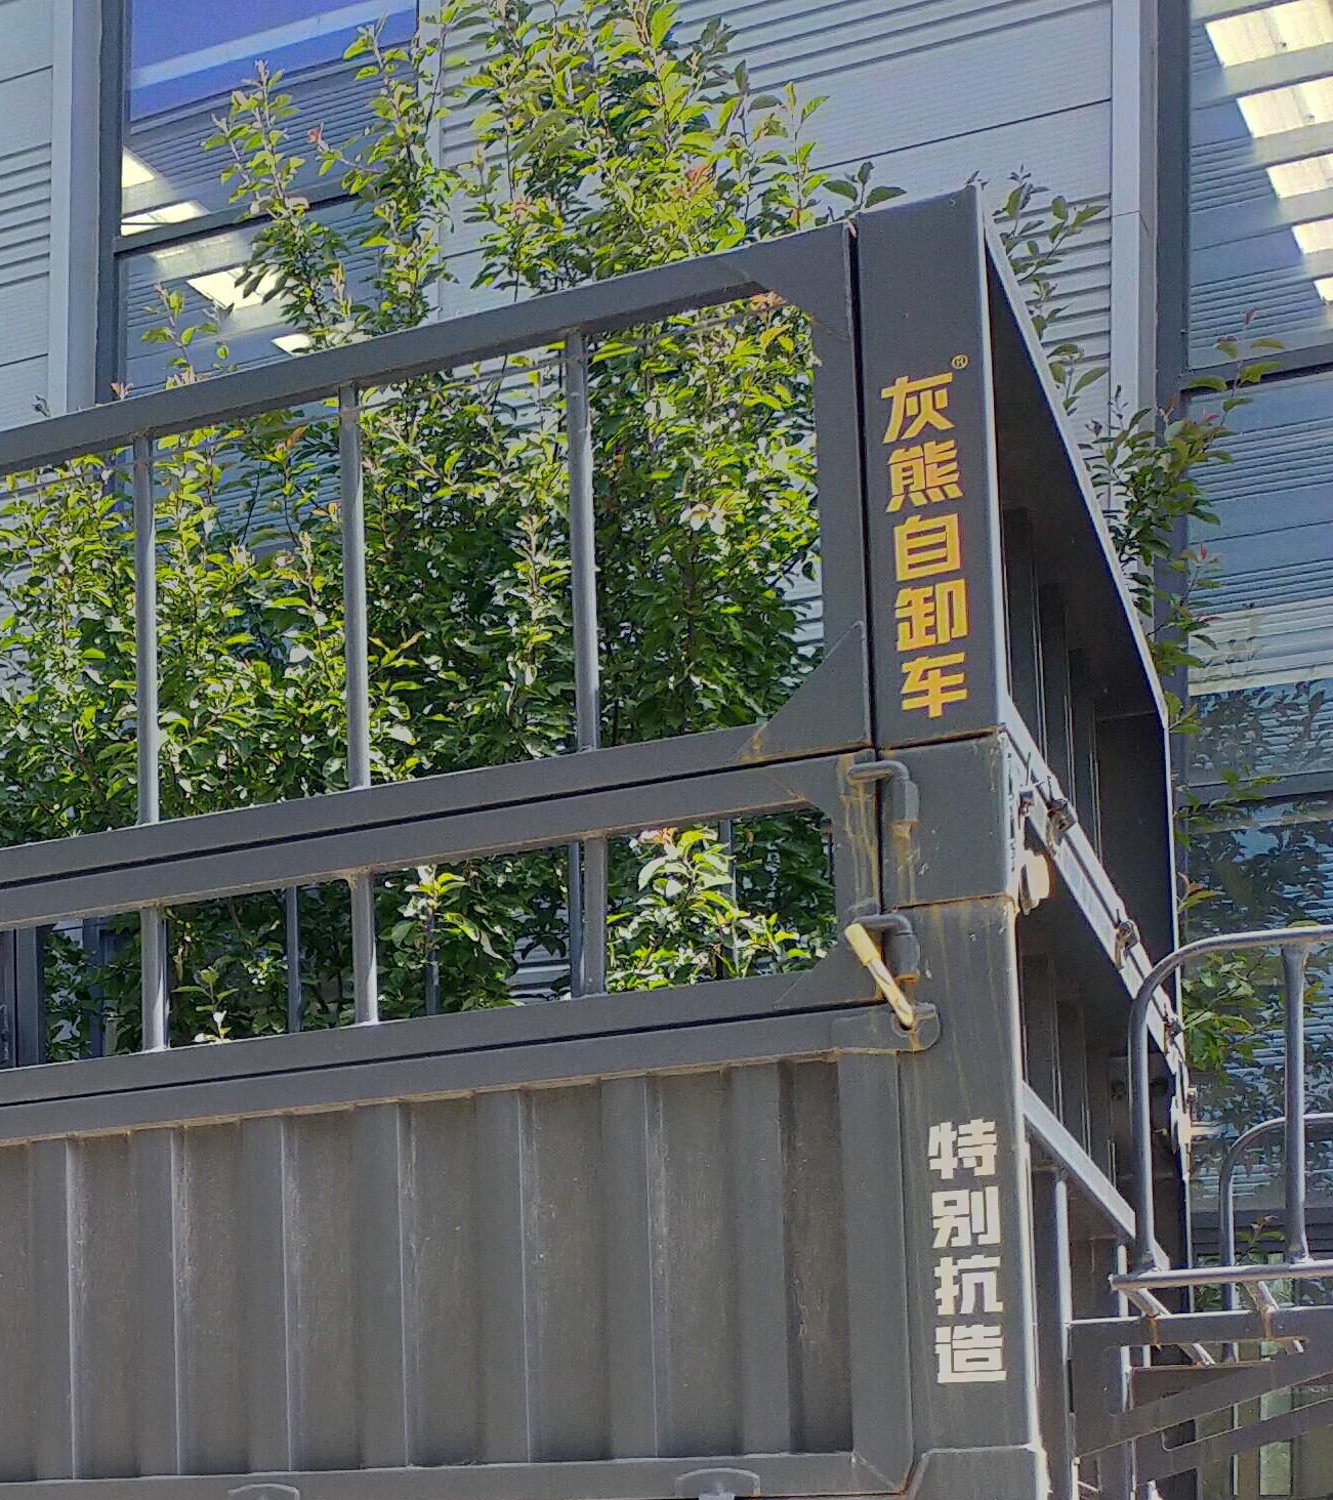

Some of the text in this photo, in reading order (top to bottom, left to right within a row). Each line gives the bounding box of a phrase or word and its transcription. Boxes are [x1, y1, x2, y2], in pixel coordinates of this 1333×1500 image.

[881, 372, 969, 719] 灰熊自卸车
[927, 1118, 1007, 1384] 特别抗造
